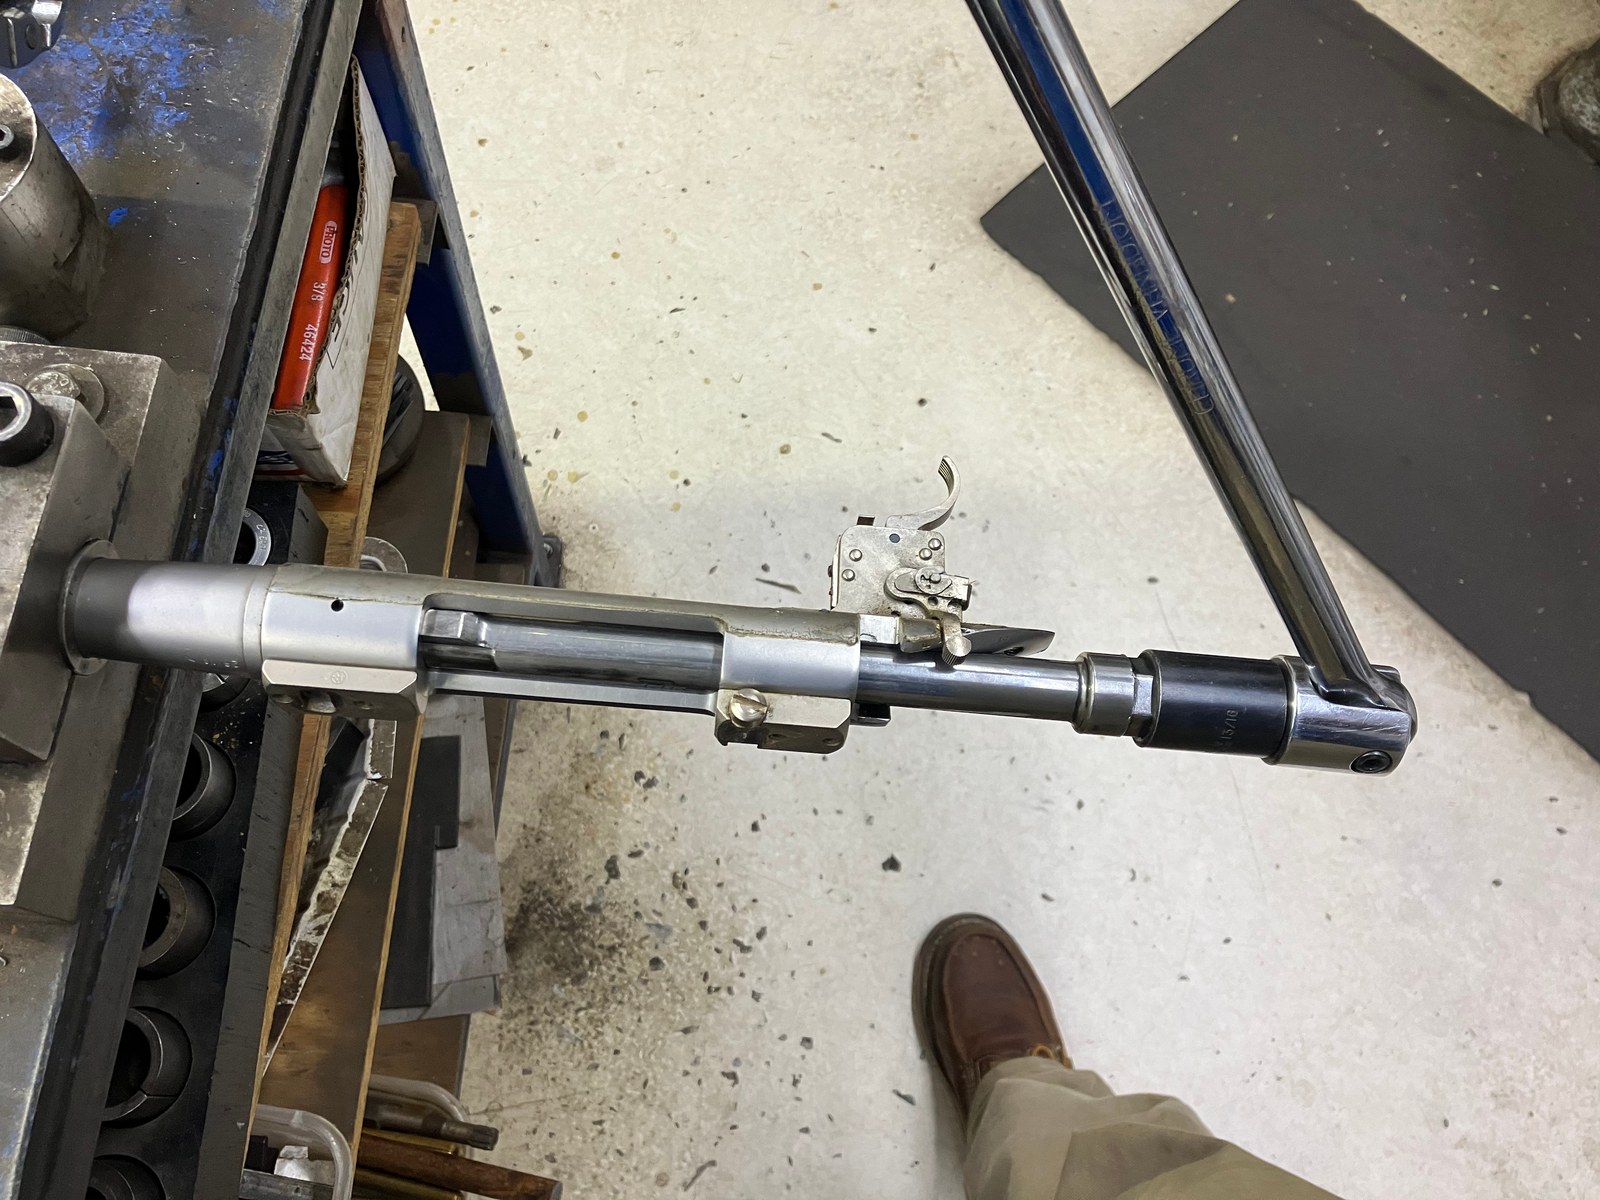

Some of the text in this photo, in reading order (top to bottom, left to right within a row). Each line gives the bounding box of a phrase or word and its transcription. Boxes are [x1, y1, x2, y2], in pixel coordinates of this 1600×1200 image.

[320, 225, 336, 259] PROTO
[311, 281, 327, 302] 3/8
[299, 323, 319, 361] 46424
